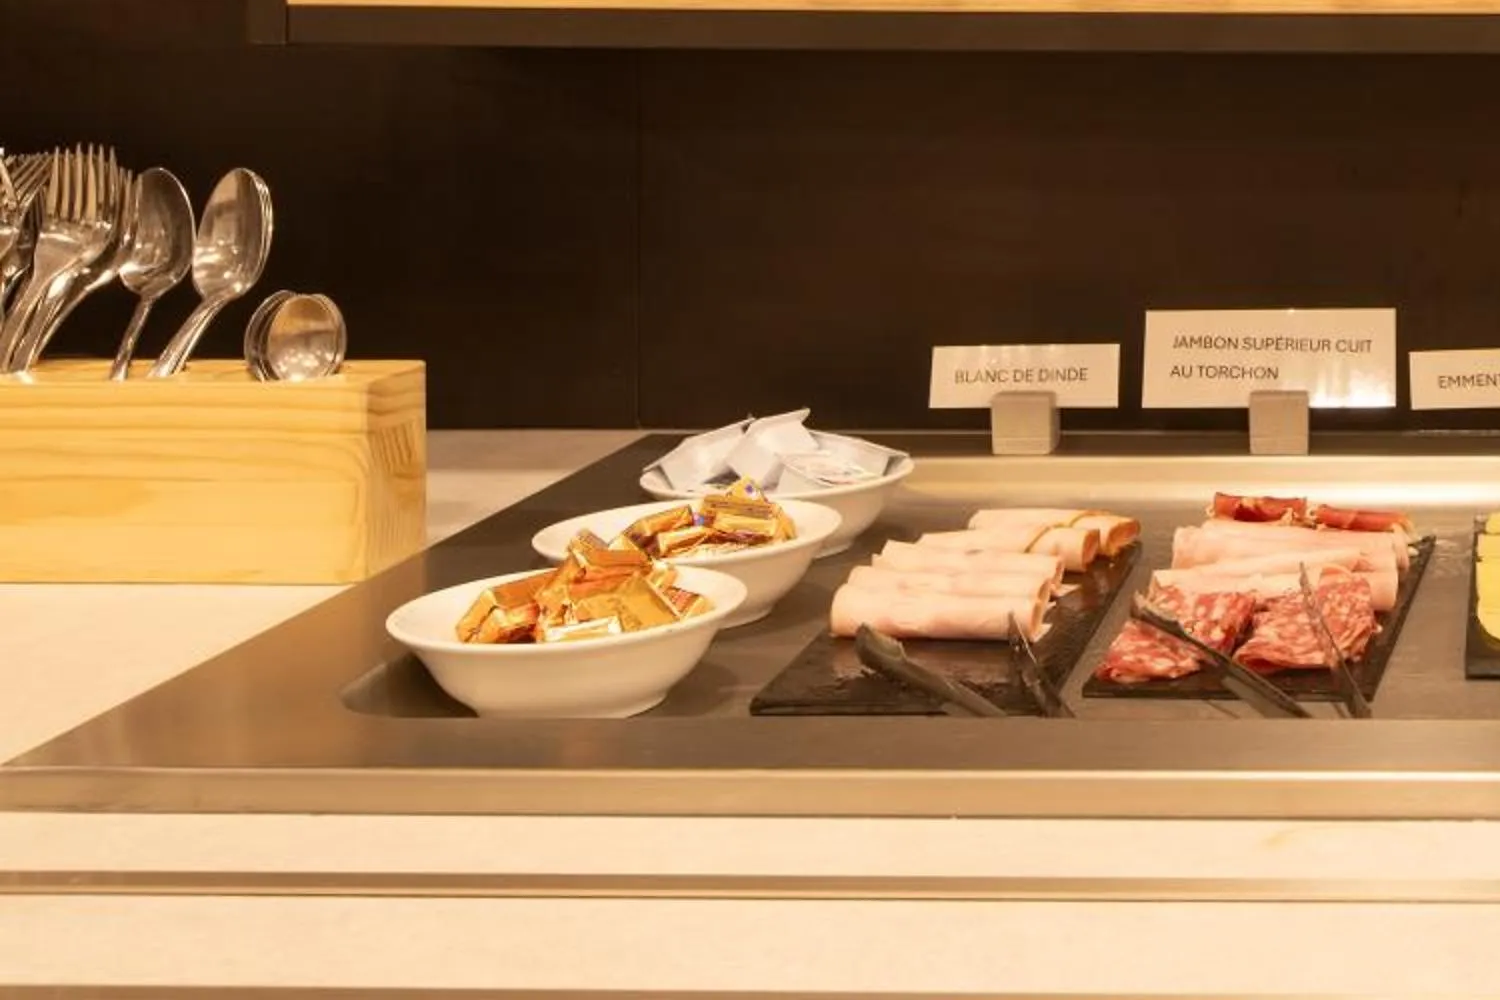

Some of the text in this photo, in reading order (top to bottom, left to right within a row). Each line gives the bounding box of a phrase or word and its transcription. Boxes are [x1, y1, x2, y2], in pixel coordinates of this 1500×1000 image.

[1173, 334, 1239, 350] JAMBON
[1335, 340, 1372, 353] CUIT
[955, 367, 1089, 384] BLANC DE DINDE
[1170, 365, 1280, 380] AU TORCHON
